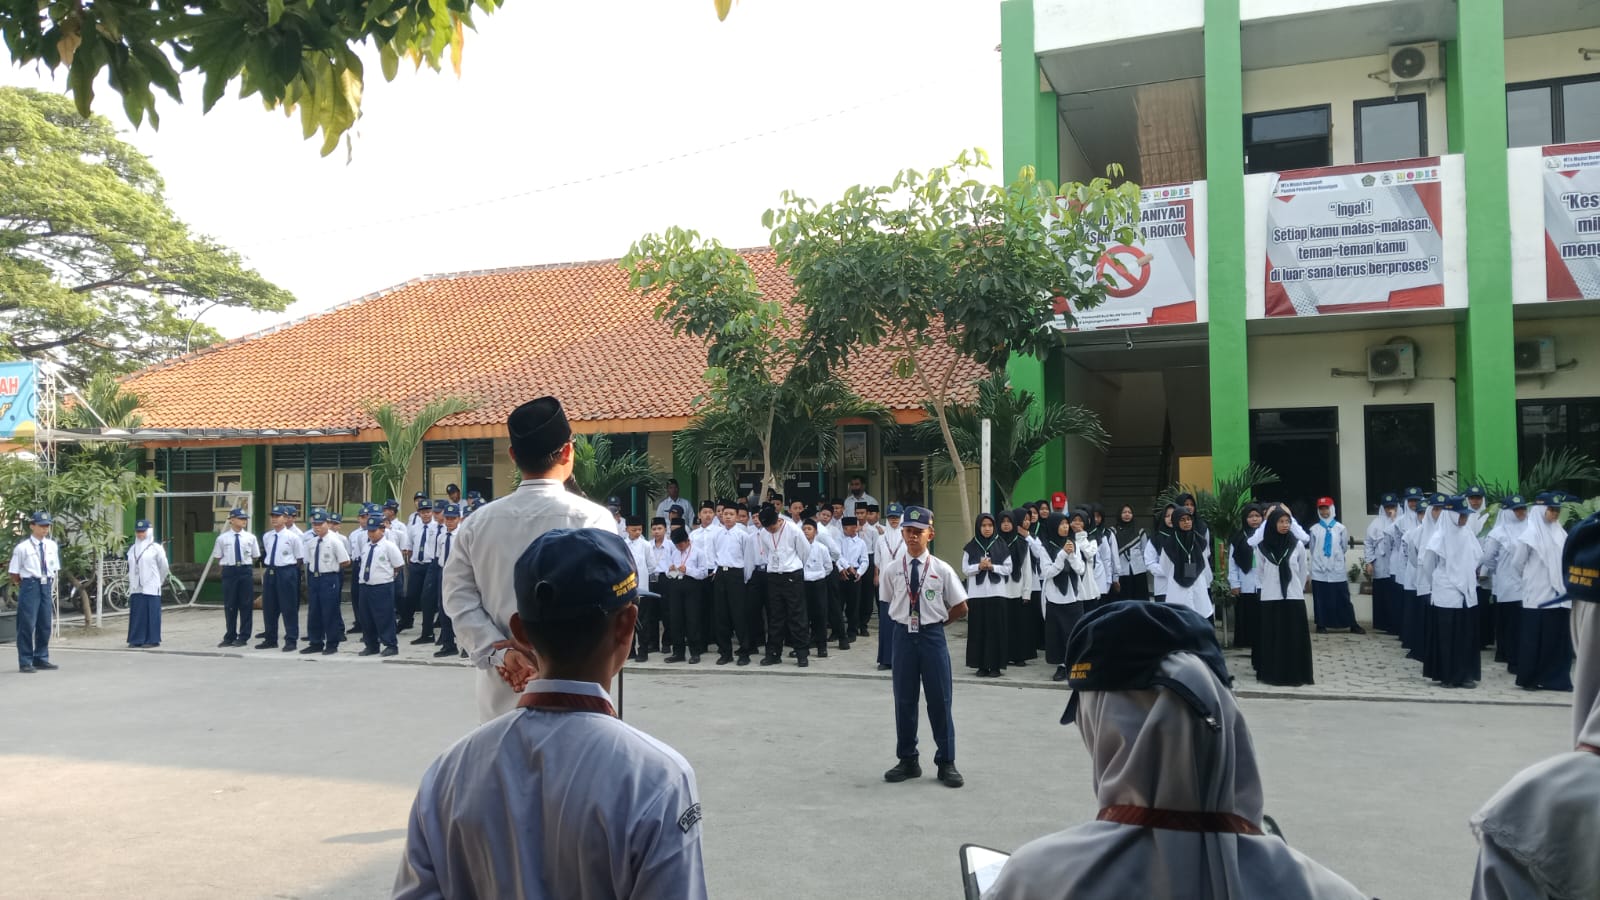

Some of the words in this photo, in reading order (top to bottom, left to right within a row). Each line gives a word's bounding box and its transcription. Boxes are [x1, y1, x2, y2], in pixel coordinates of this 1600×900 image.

[1150, 223, 1185, 238] ROKOK
[1274, 228, 1308, 241] Setiap
[1310, 226, 1339, 239] kamu
[1298, 243, 1374, 260] teman-teman
[1376, 241, 1406, 254] kamu
[1271, 268, 1280, 281] di
[1282, 268, 1305, 281] luar
[1307, 266, 1333, 279] sana
[1335, 264, 1366, 277] terus
